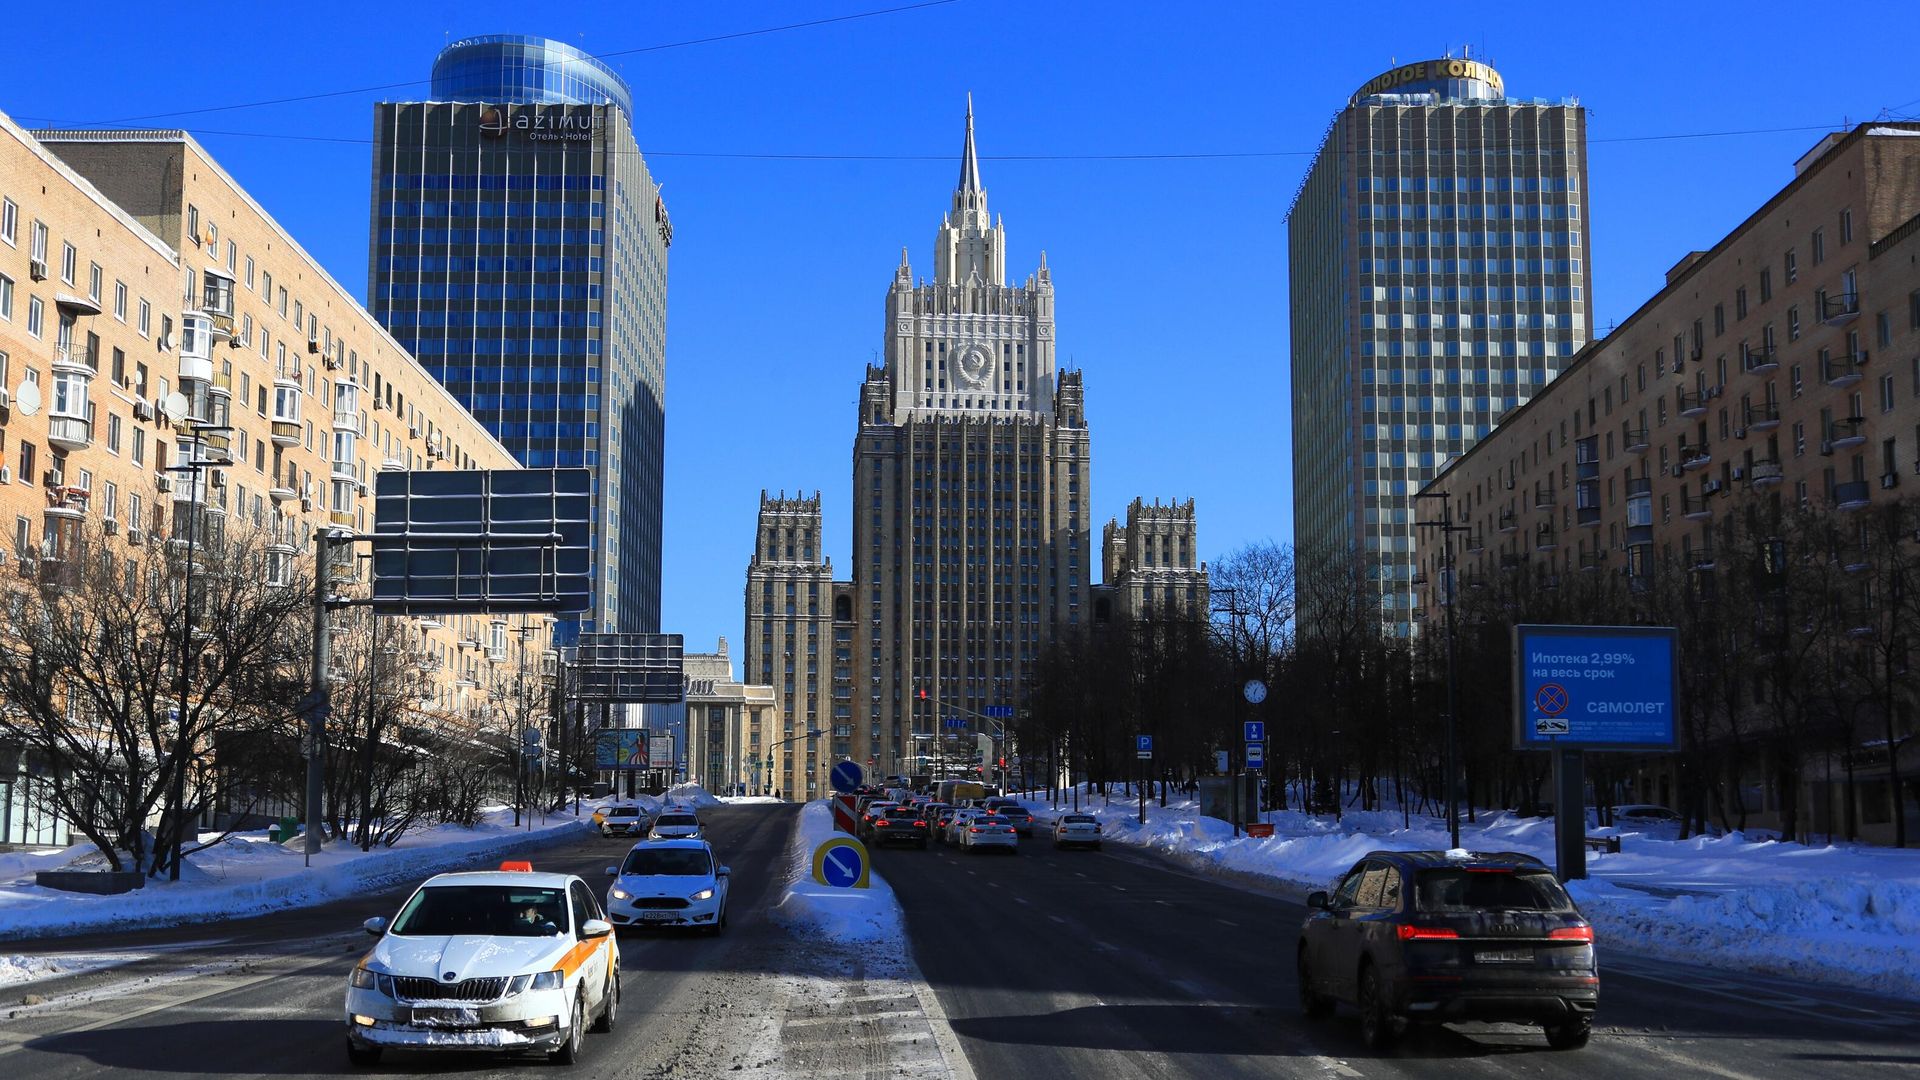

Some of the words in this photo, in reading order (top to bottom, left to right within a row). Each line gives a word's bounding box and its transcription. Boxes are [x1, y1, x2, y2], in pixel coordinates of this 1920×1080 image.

[1358, 66, 1424, 97] ОЛОТОЕ
[529, 132, 559, 140] Отель
[565, 132, 592, 141] Hotel
[1532, 652, 1588, 663] Ипотека
[1591, 652, 1636, 666] 2,99%
[1532, 668, 1548, 678] на
[1551, 668, 1581, 678] весь
[1584, 669, 1615, 681] срок
[1586, 701, 1665, 714] самолет
[1141, 737, 1150, 748] P
